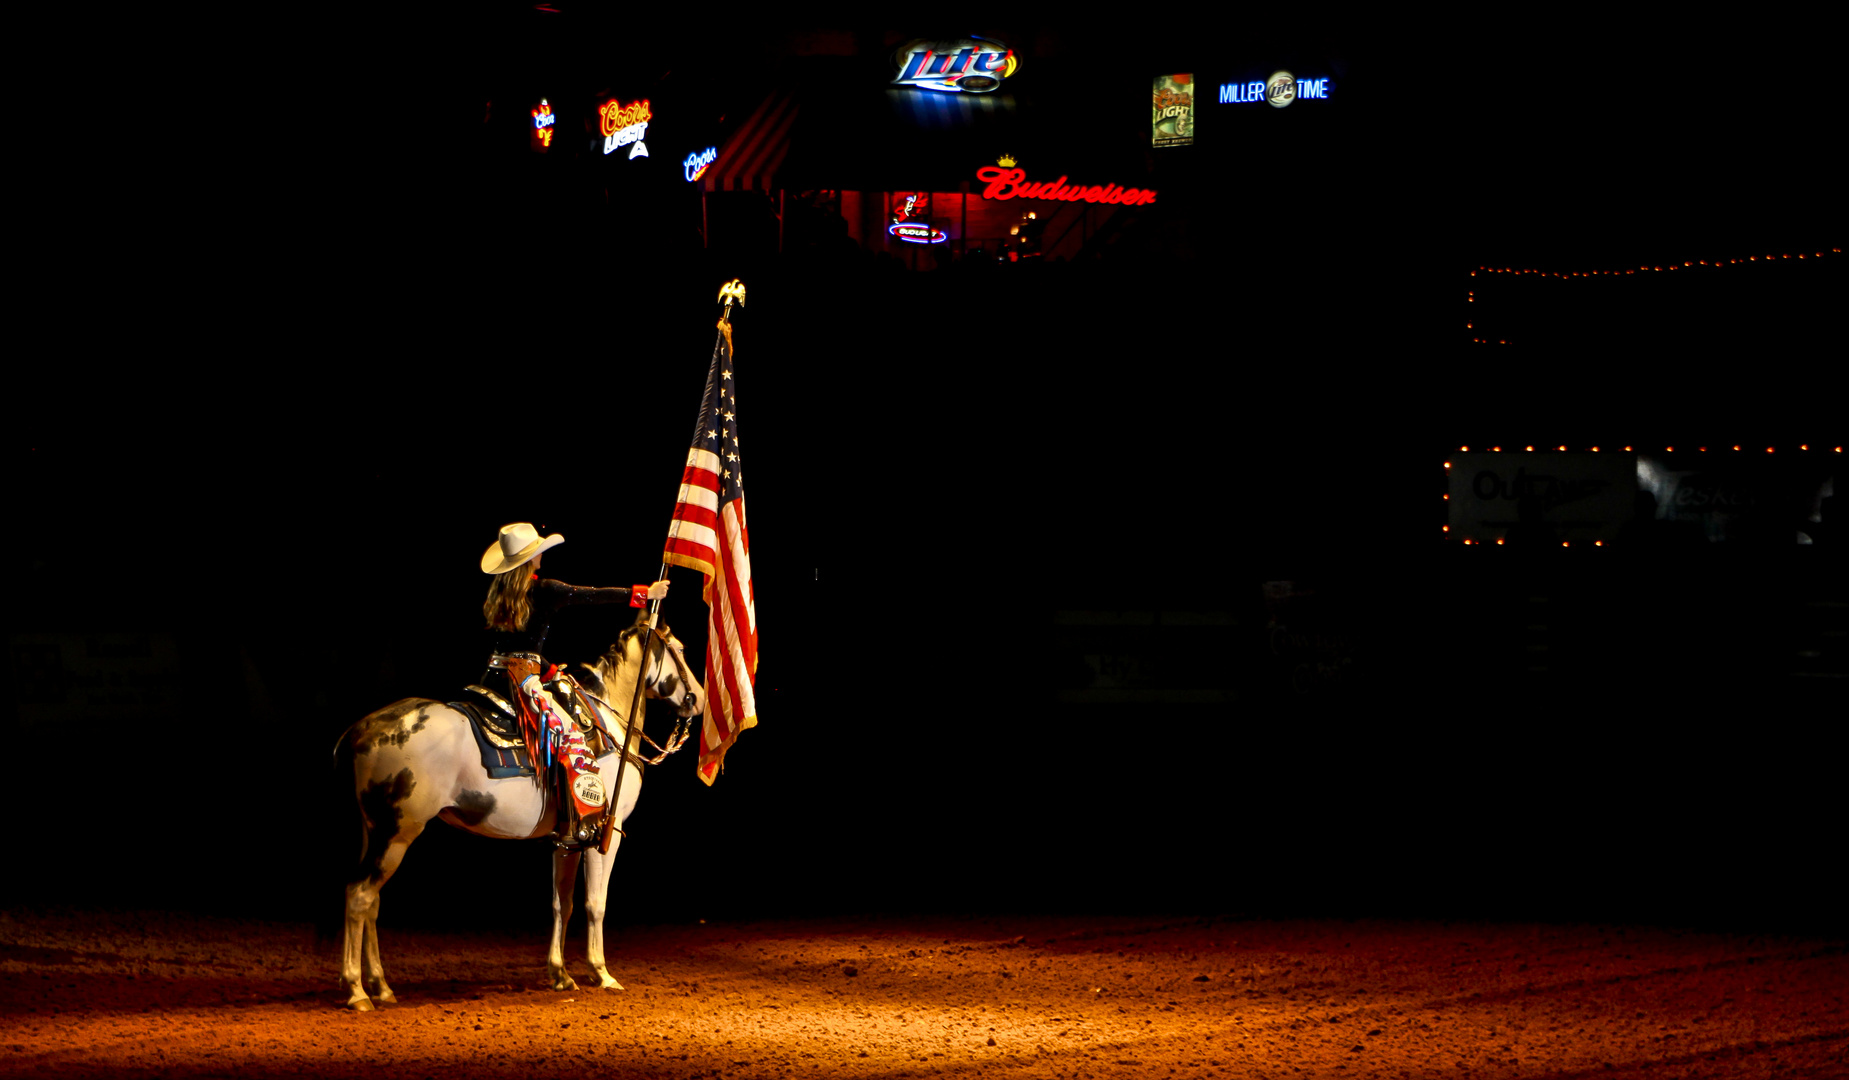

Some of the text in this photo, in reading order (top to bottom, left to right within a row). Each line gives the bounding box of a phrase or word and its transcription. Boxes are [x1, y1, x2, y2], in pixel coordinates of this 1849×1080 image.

[897, 46, 1008, 80] Lite
[1220, 82, 1266, 104] MILLER
[1296, 78, 1329, 99] TIME
[599, 99, 652, 137] Coors
[1156, 105, 1189, 122] LIGHT
[603, 121, 649, 155] LIGHT
[976, 166, 1157, 206] Budweiser
